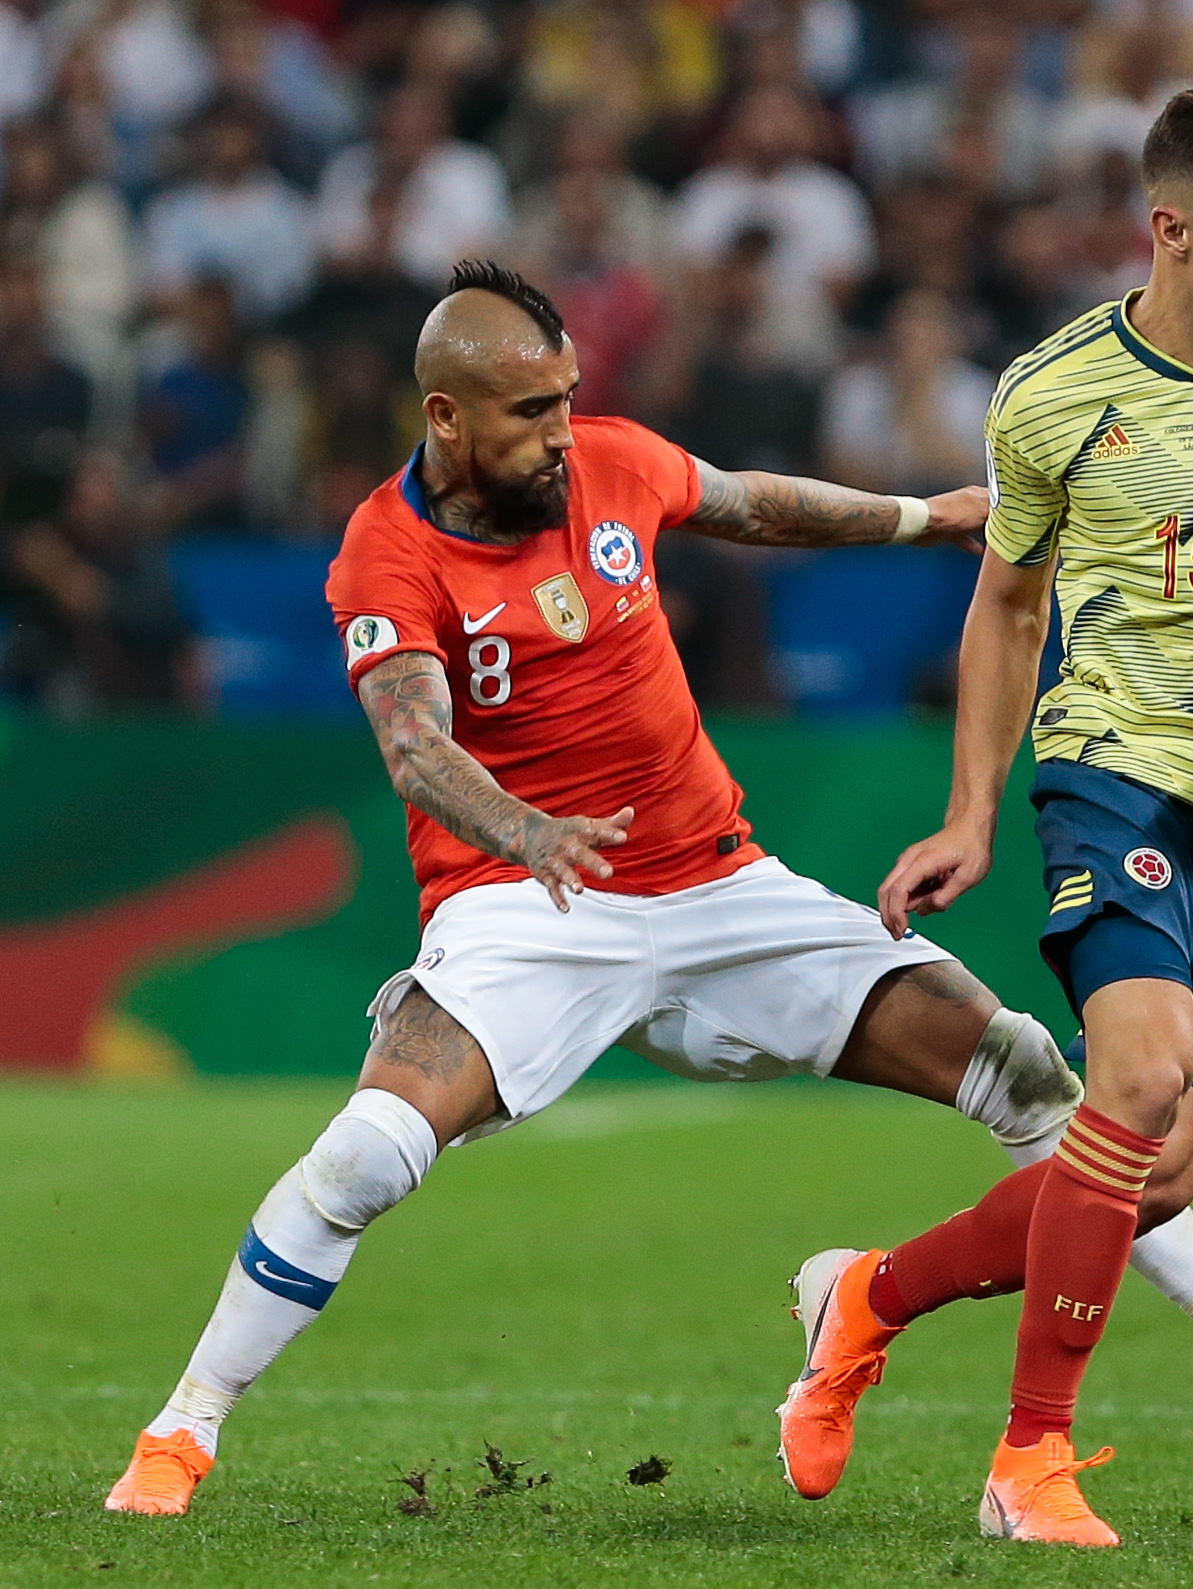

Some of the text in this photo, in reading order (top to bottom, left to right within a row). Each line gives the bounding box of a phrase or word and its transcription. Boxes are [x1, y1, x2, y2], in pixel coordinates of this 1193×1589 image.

[1093, 445, 1138, 459] adidas
[468, 635, 511, 706] 8
[1053, 1293, 1104, 1322] FCF
